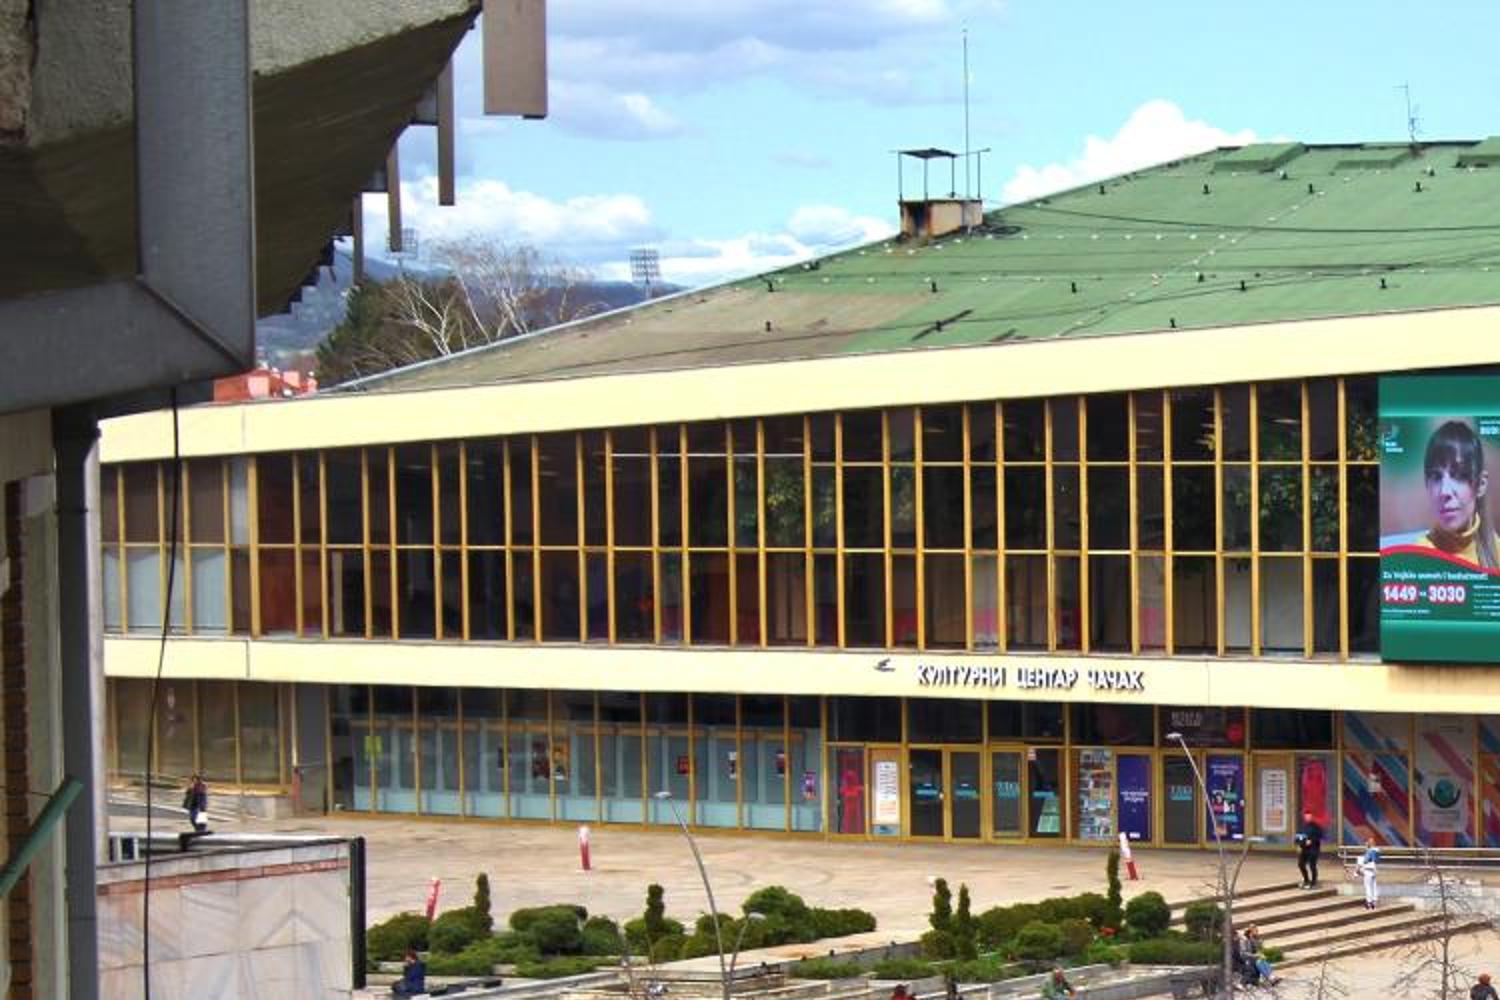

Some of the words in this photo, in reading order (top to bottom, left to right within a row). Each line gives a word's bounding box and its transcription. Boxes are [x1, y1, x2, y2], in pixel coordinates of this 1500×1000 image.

[1383, 585, 1417, 601] 1449
[1428, 585, 1466, 602] 3030
[917, 664, 1007, 688] КУЛТУРНИ
[1017, 667, 1079, 690] ЦЕНТАР
[1087, 669, 1146, 692] ЧАЧАК
